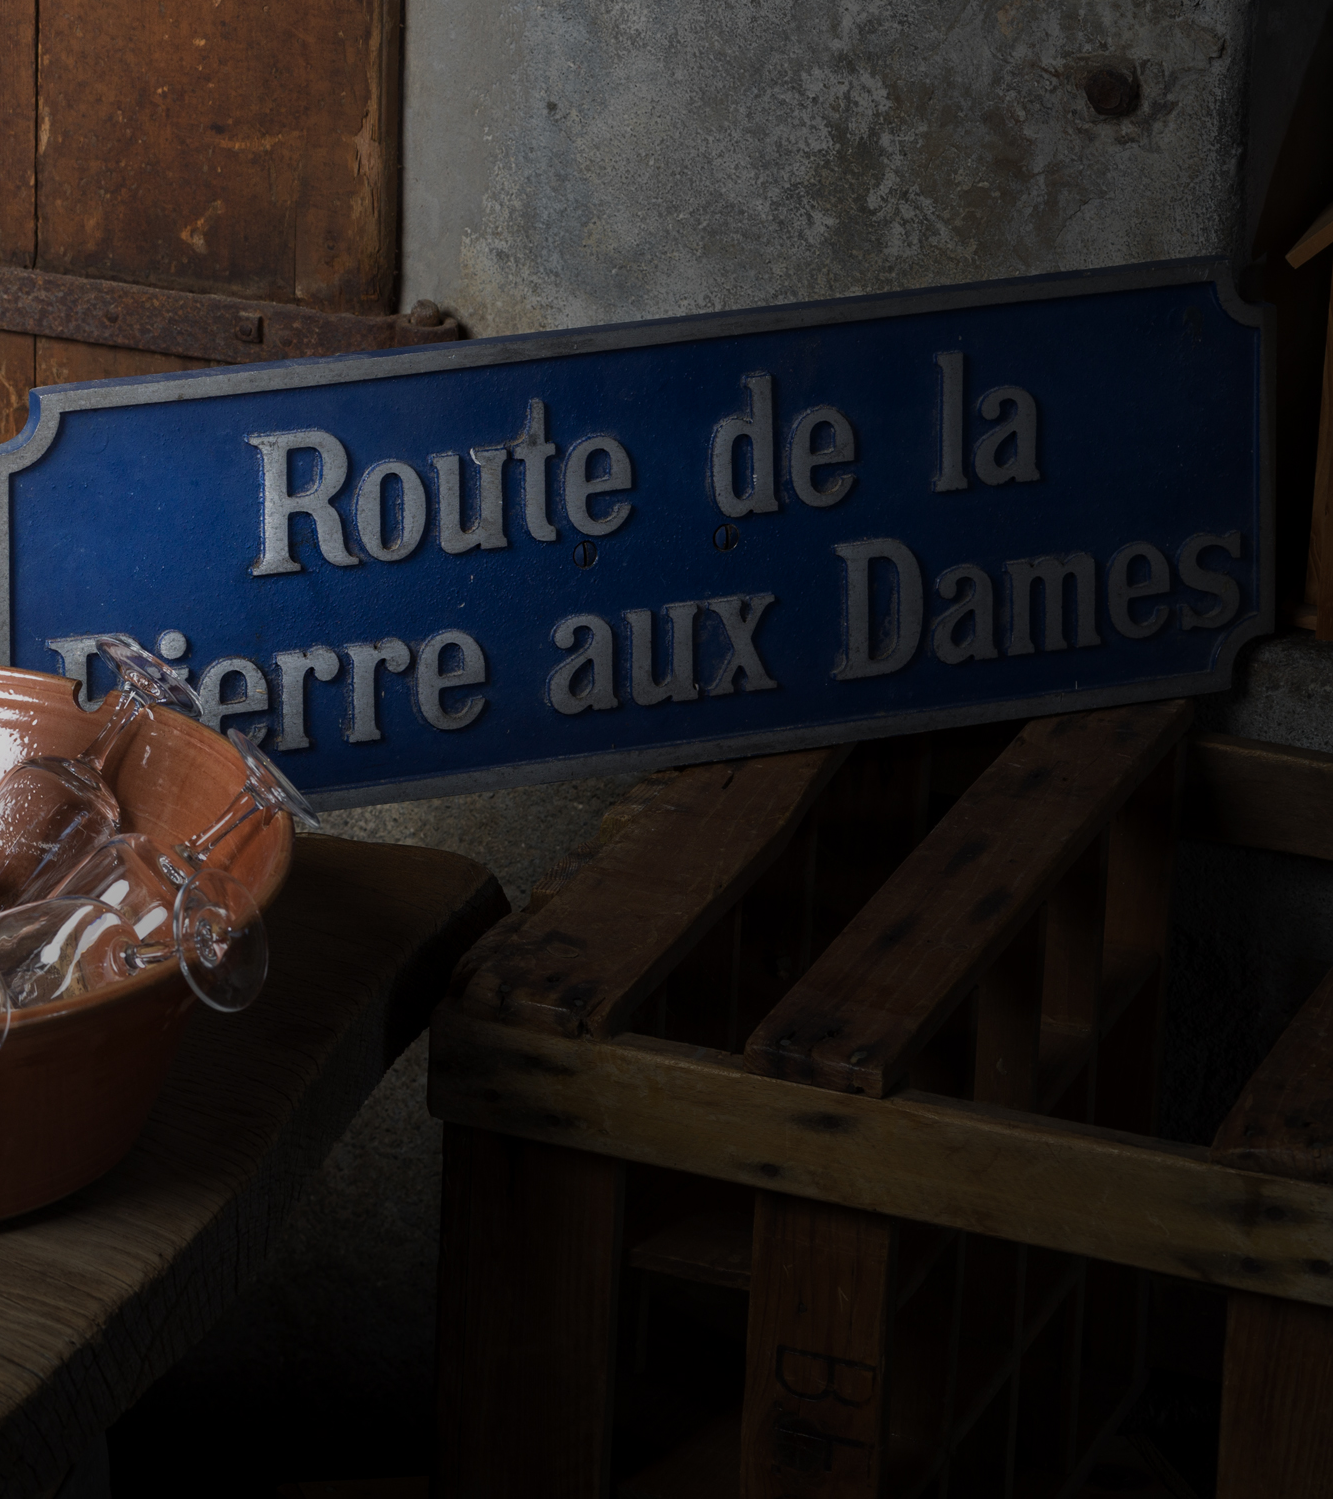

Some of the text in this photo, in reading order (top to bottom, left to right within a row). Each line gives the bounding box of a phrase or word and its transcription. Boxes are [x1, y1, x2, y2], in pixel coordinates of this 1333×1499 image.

[244, 347, 1041, 579] Route de la
[545, 592, 777, 717] aux
[832, 525, 1244, 685] Dames
